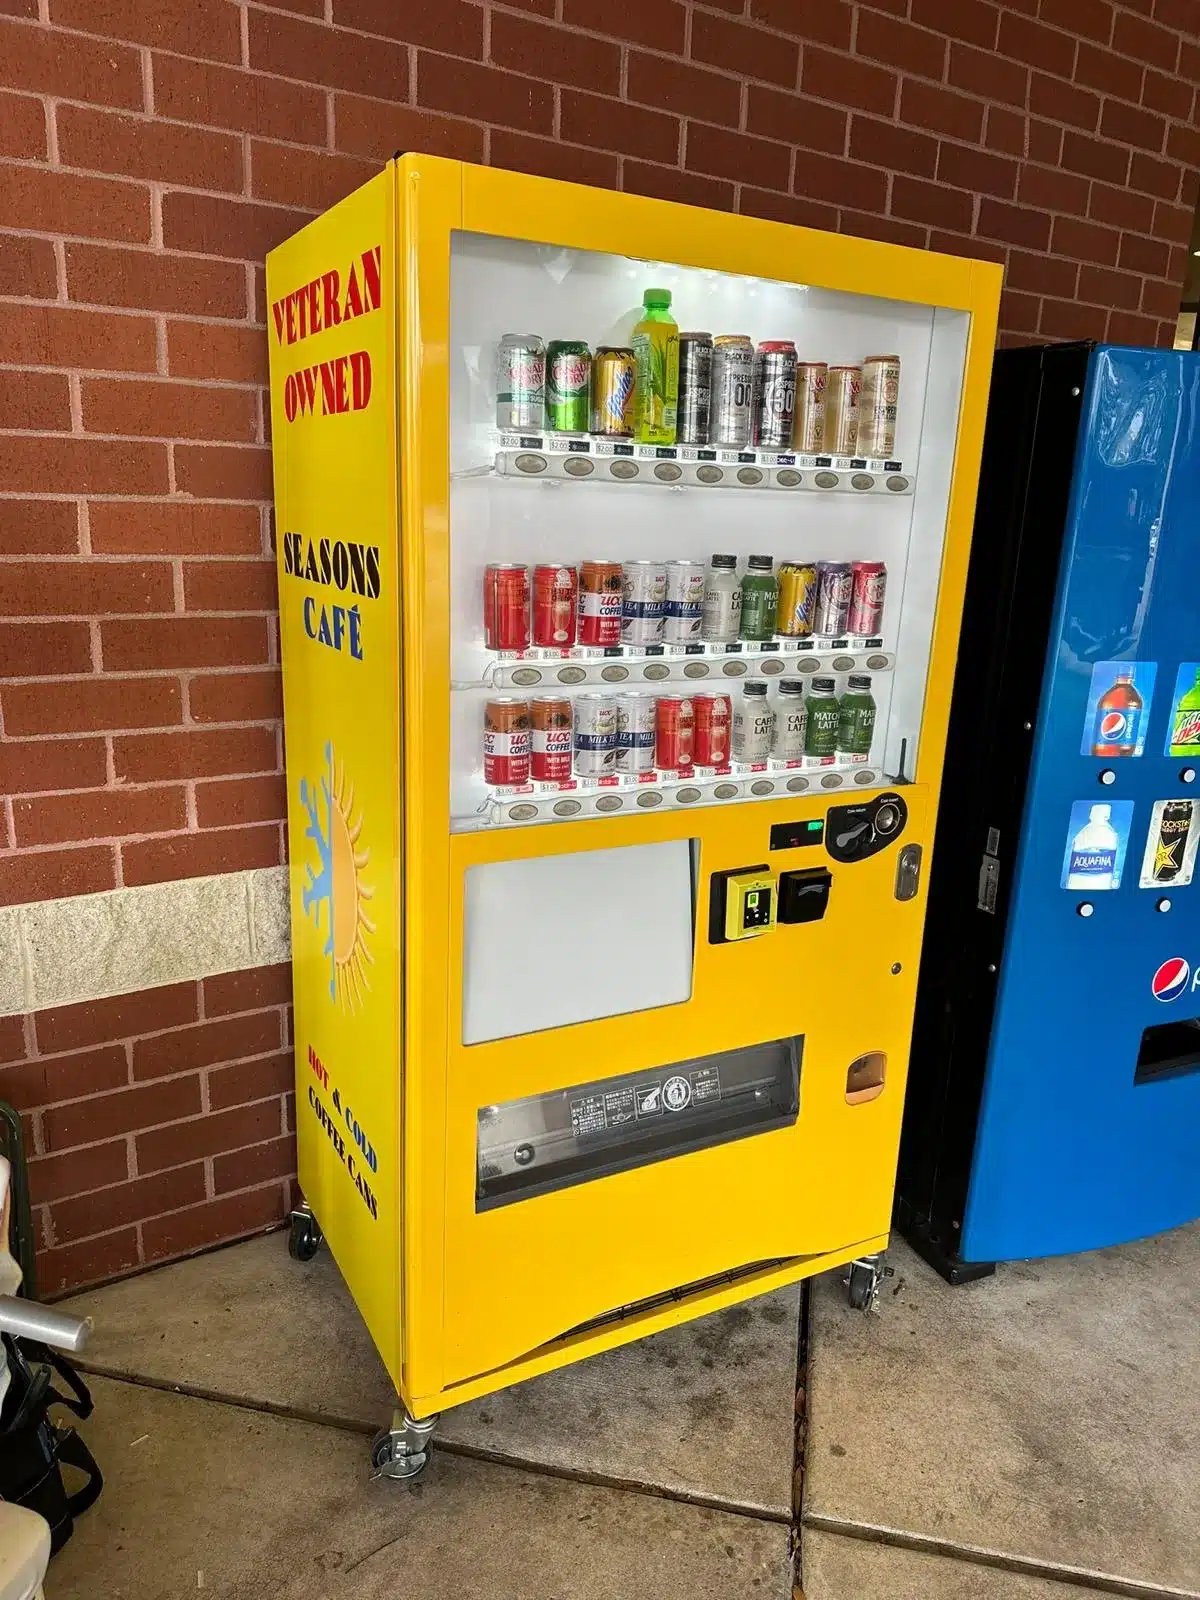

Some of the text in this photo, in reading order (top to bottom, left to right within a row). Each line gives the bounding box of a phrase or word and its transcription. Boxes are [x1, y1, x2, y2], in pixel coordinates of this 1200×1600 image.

[272, 245, 381, 348] VETERAN
[506, 362, 545, 382] CANAD
[552, 362, 588, 381] CANAD
[724, 374, 752, 383] ESPRESS
[284, 351, 372, 423] OWNED
[502, 437, 519, 445] $2.00
[551, 441, 567, 449] $2.00
[283, 532, 380, 600] SEASONS
[623, 602, 637, 610] TEA
[304, 596, 363, 661] CAFÉ
[788, 715, 807, 723] CAFF
[546, 731, 570, 743] UCC
[589, 735, 608, 744] MILK
[619, 732, 632, 741] TEA
[545, 742, 570, 752] COFFEE
[1074, 856, 1112, 867] AQUAFINA
[308, 1044, 329, 1091] HOT
[345, 1107, 378, 1173] COLD
[308, 1085, 378, 1221] COFFEE CANS
